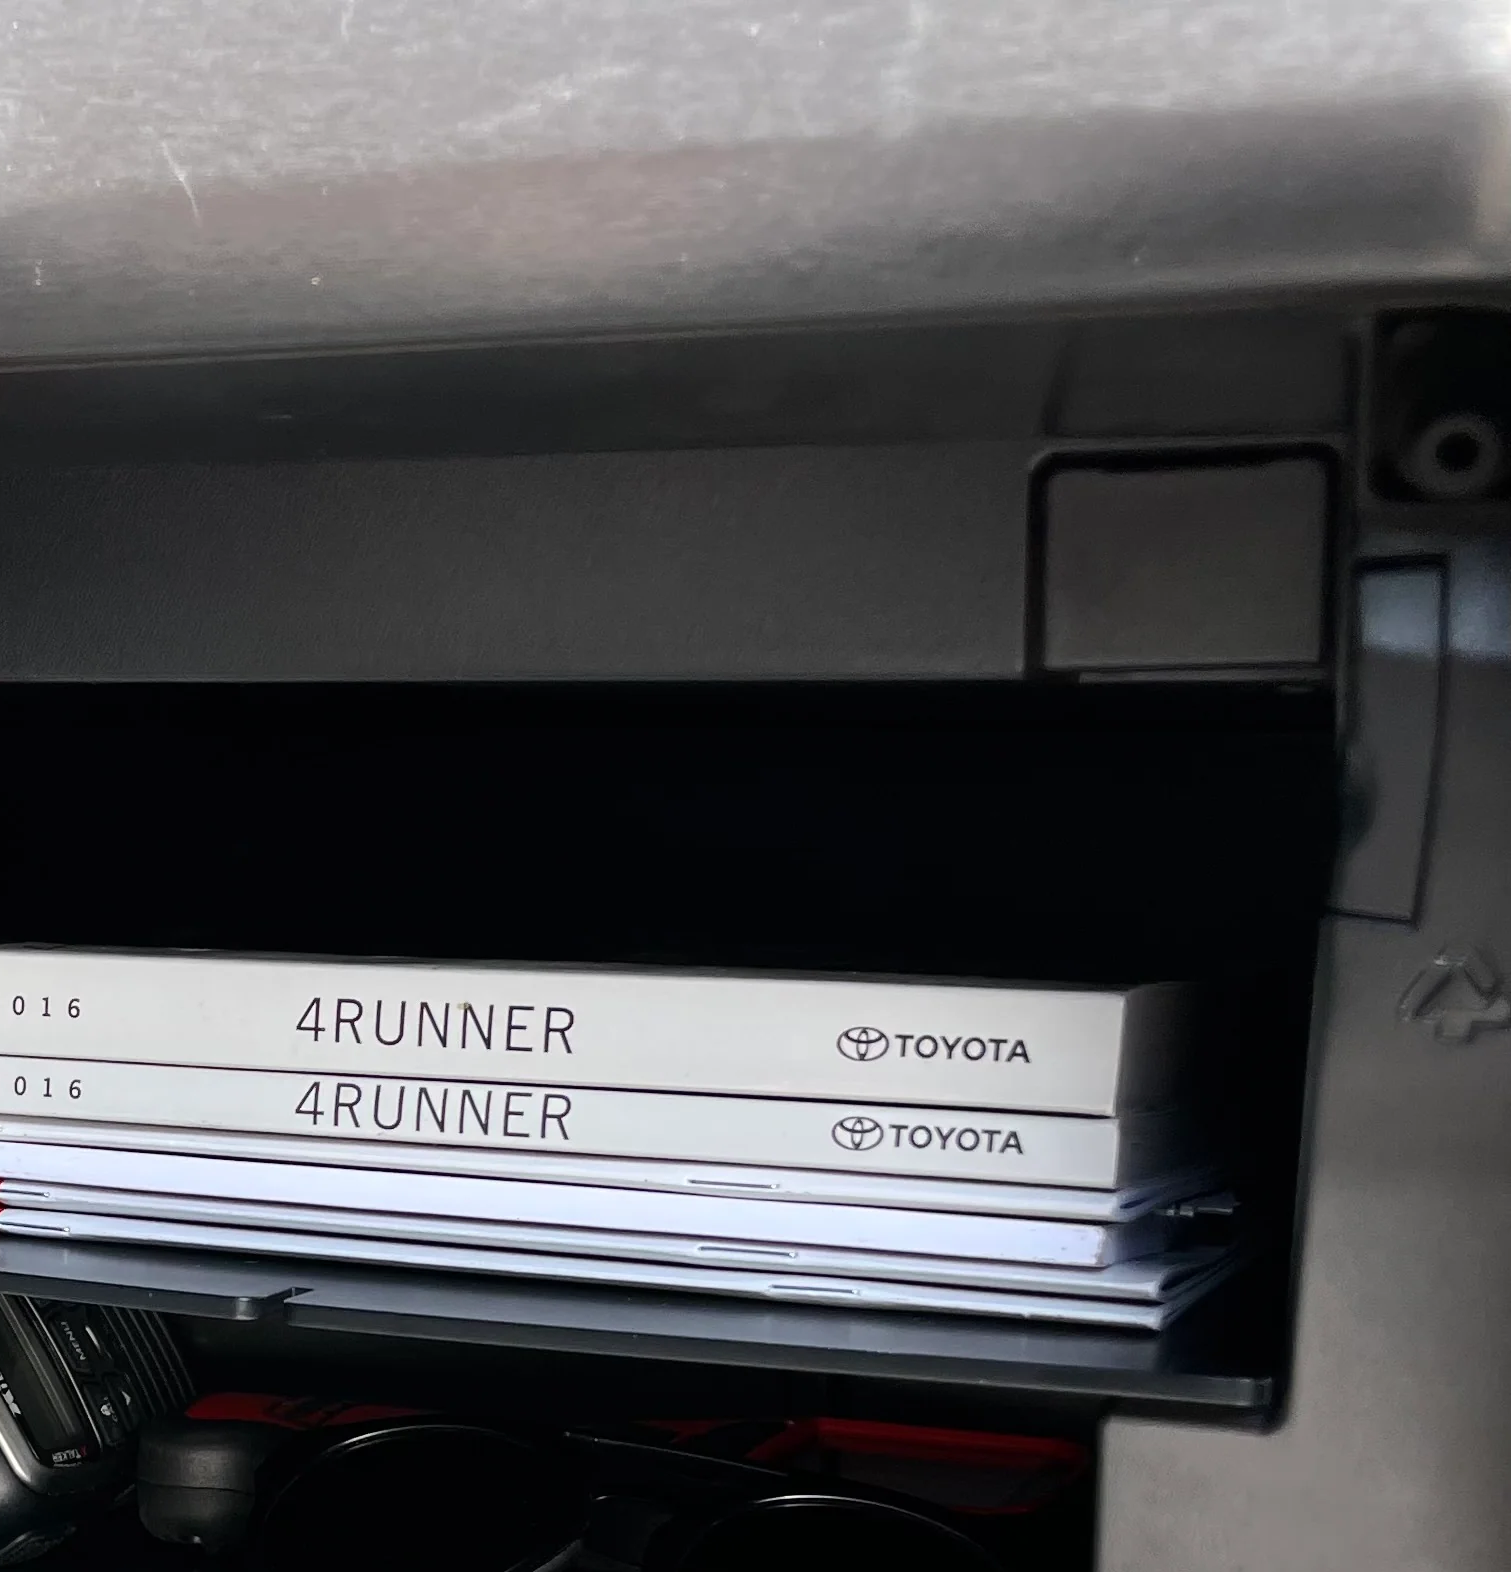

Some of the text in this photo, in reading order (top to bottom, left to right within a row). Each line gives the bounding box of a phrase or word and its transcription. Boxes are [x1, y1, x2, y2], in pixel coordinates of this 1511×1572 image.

[295, 997, 575, 1054] 4RUNNER
[894, 1034, 1031, 1064] TOYOTA
[294, 1081, 573, 1141] 4RUNNER
[889, 1124, 1024, 1155] TOYOTA
[60, 1320, 88, 1362] MENU
